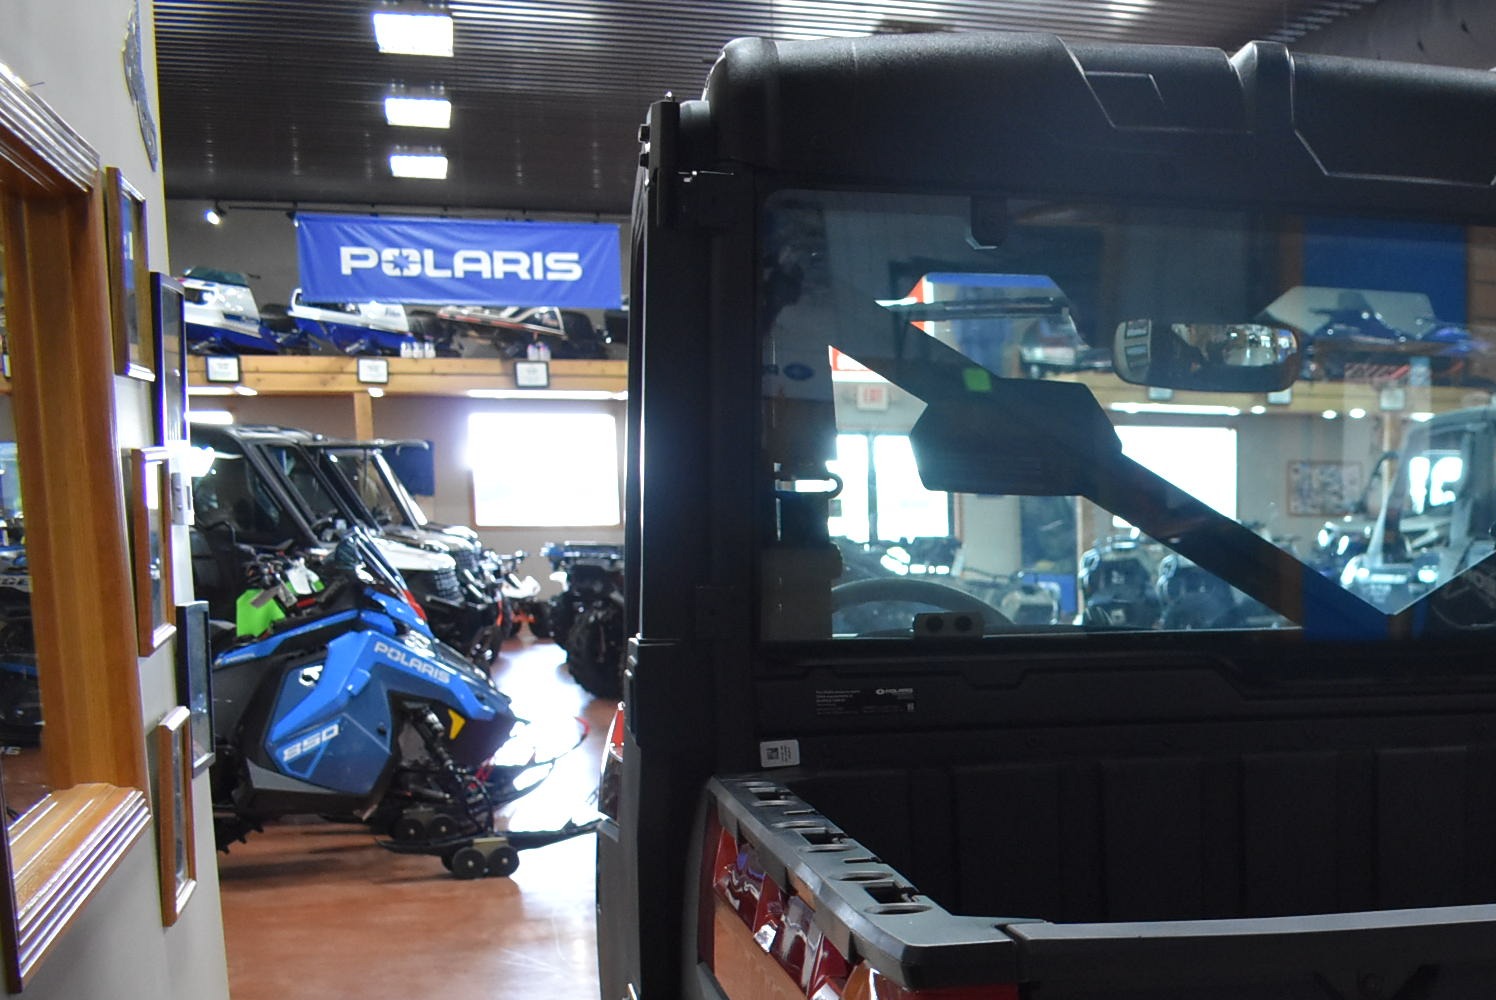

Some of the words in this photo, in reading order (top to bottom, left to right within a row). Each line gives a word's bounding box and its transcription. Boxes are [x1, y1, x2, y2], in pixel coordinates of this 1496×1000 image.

[339, 246, 583, 282] POLARIS
[373, 641, 451, 685] POLARIS
[283, 724, 340, 762] 850
